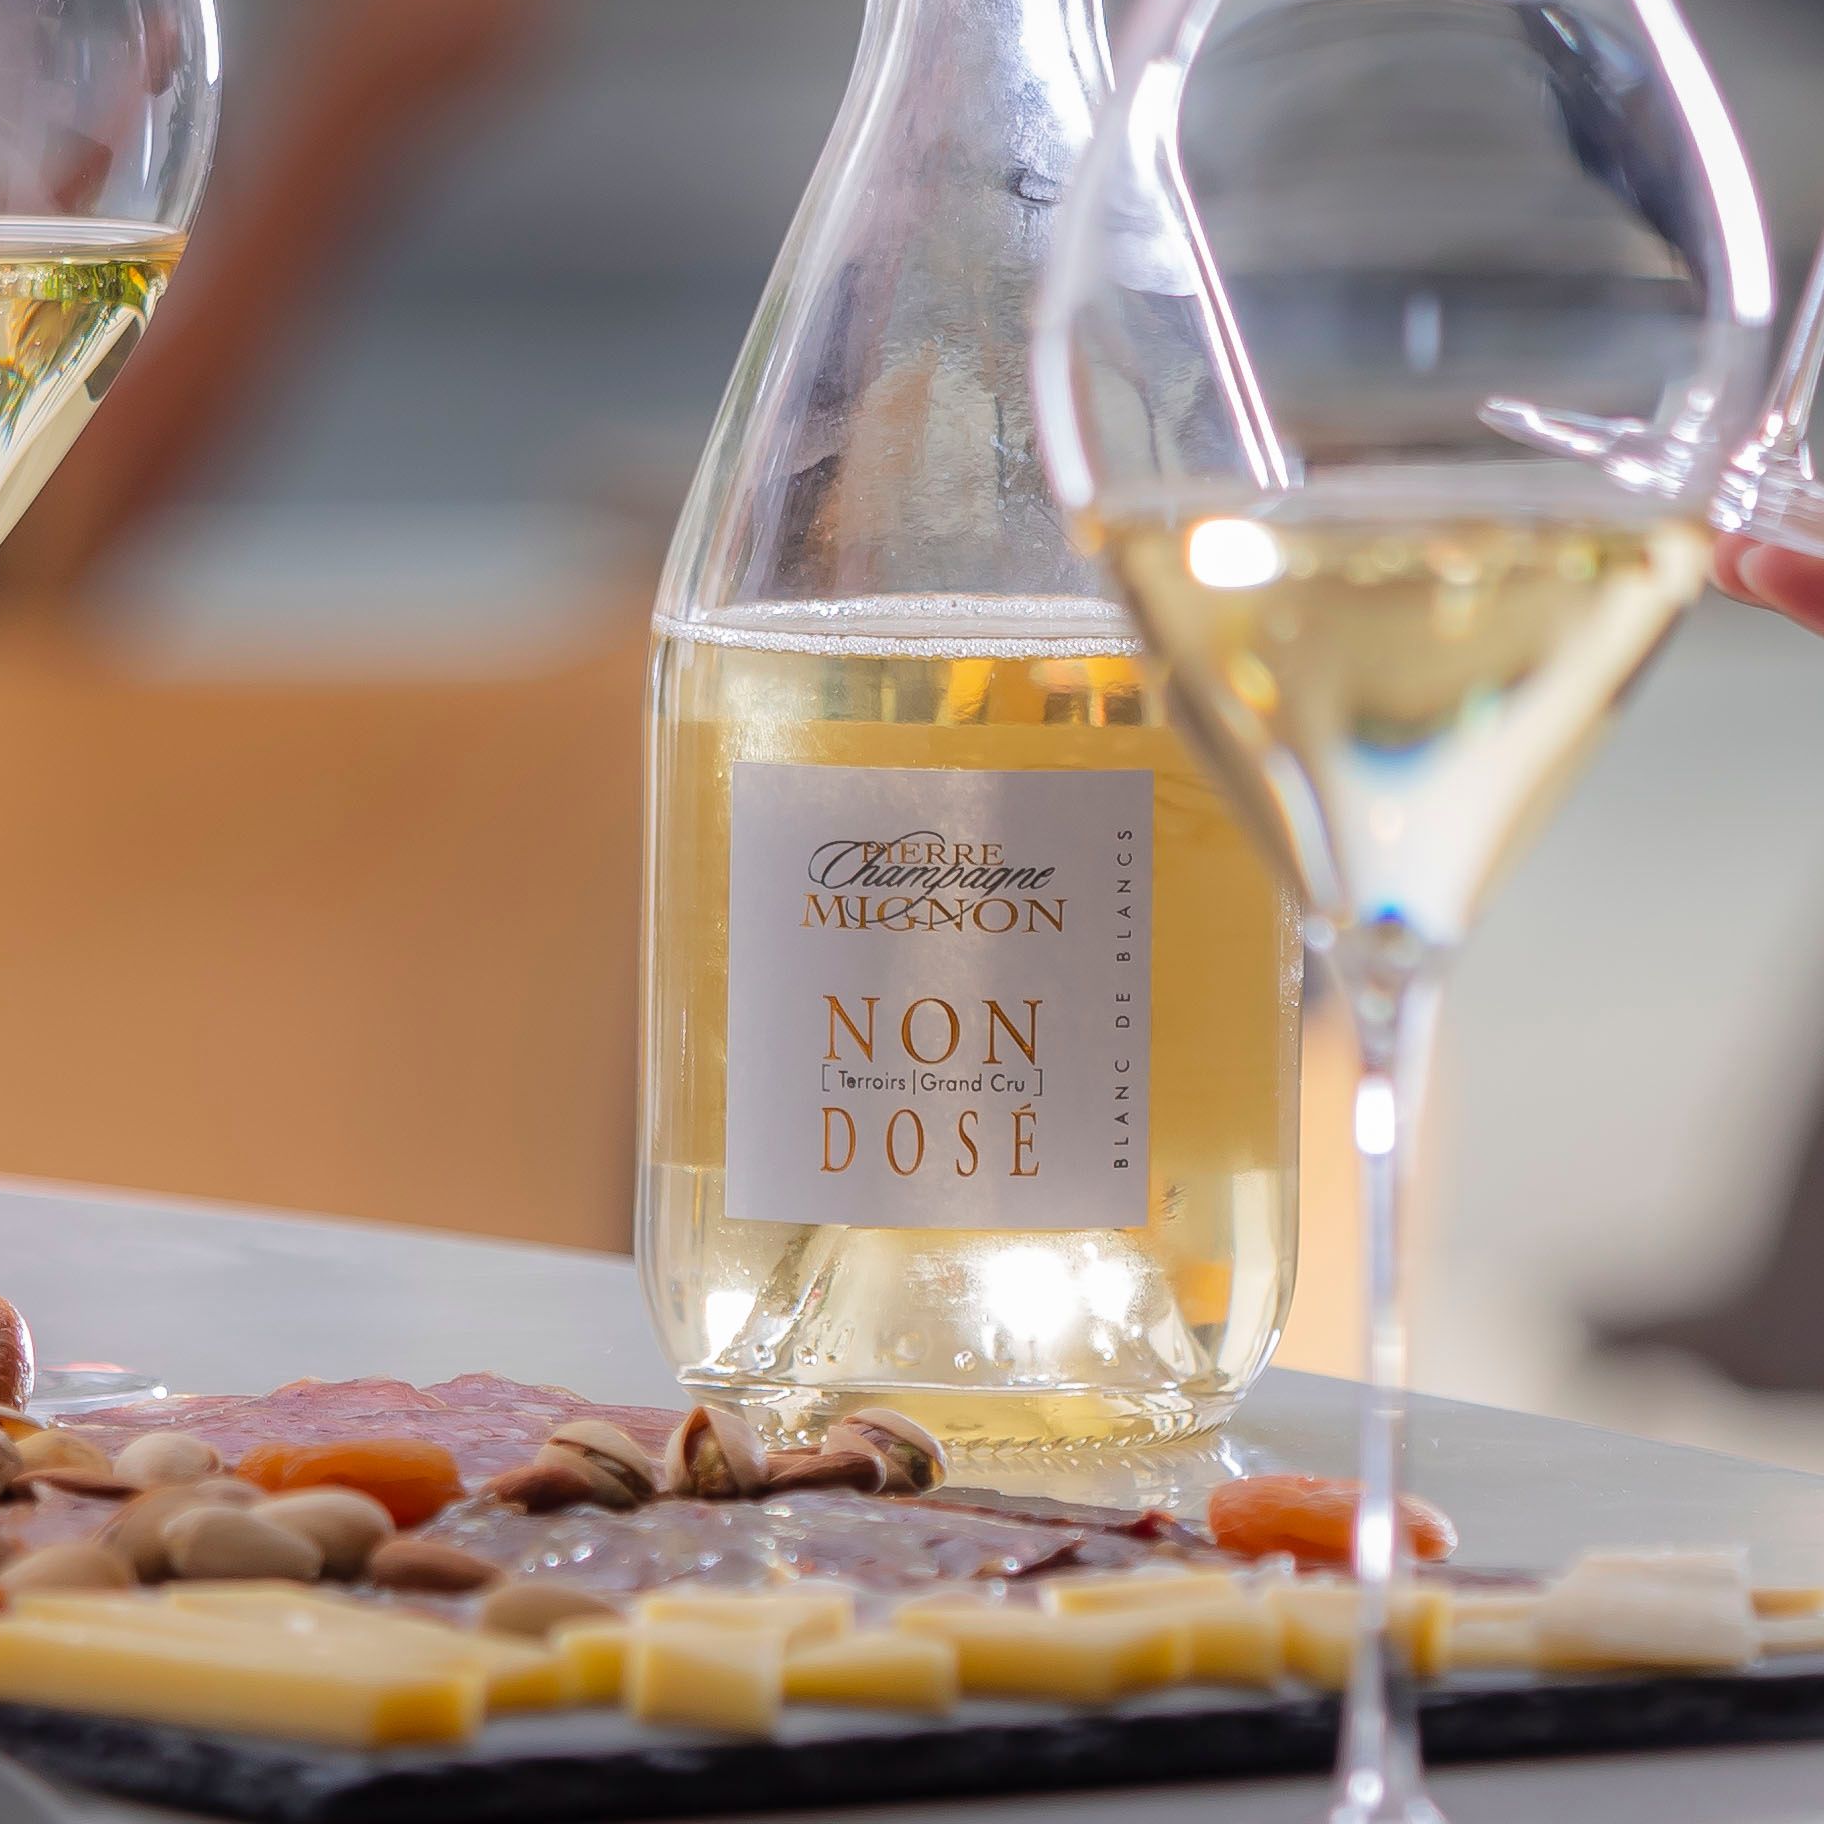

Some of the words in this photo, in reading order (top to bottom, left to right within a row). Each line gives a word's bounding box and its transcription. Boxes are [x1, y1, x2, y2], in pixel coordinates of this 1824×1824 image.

[809, 831, 1057, 914] Champagne
[861, 841, 1005, 866] PIERRE
[799, 893, 1068, 934] MIGNON
[1116, 829, 1134, 963] BLANCS
[822, 994, 1043, 1066] NON
[1115, 991, 1132, 1030] DE
[838, 1070, 906, 1092] Terroirs
[920, 1071, 983, 1094] Grand
[990, 1072, 1026, 1094] Cru
[1113, 1057, 1131, 1169] BLANC
[820, 1103, 1041, 1178] DOSÉ
